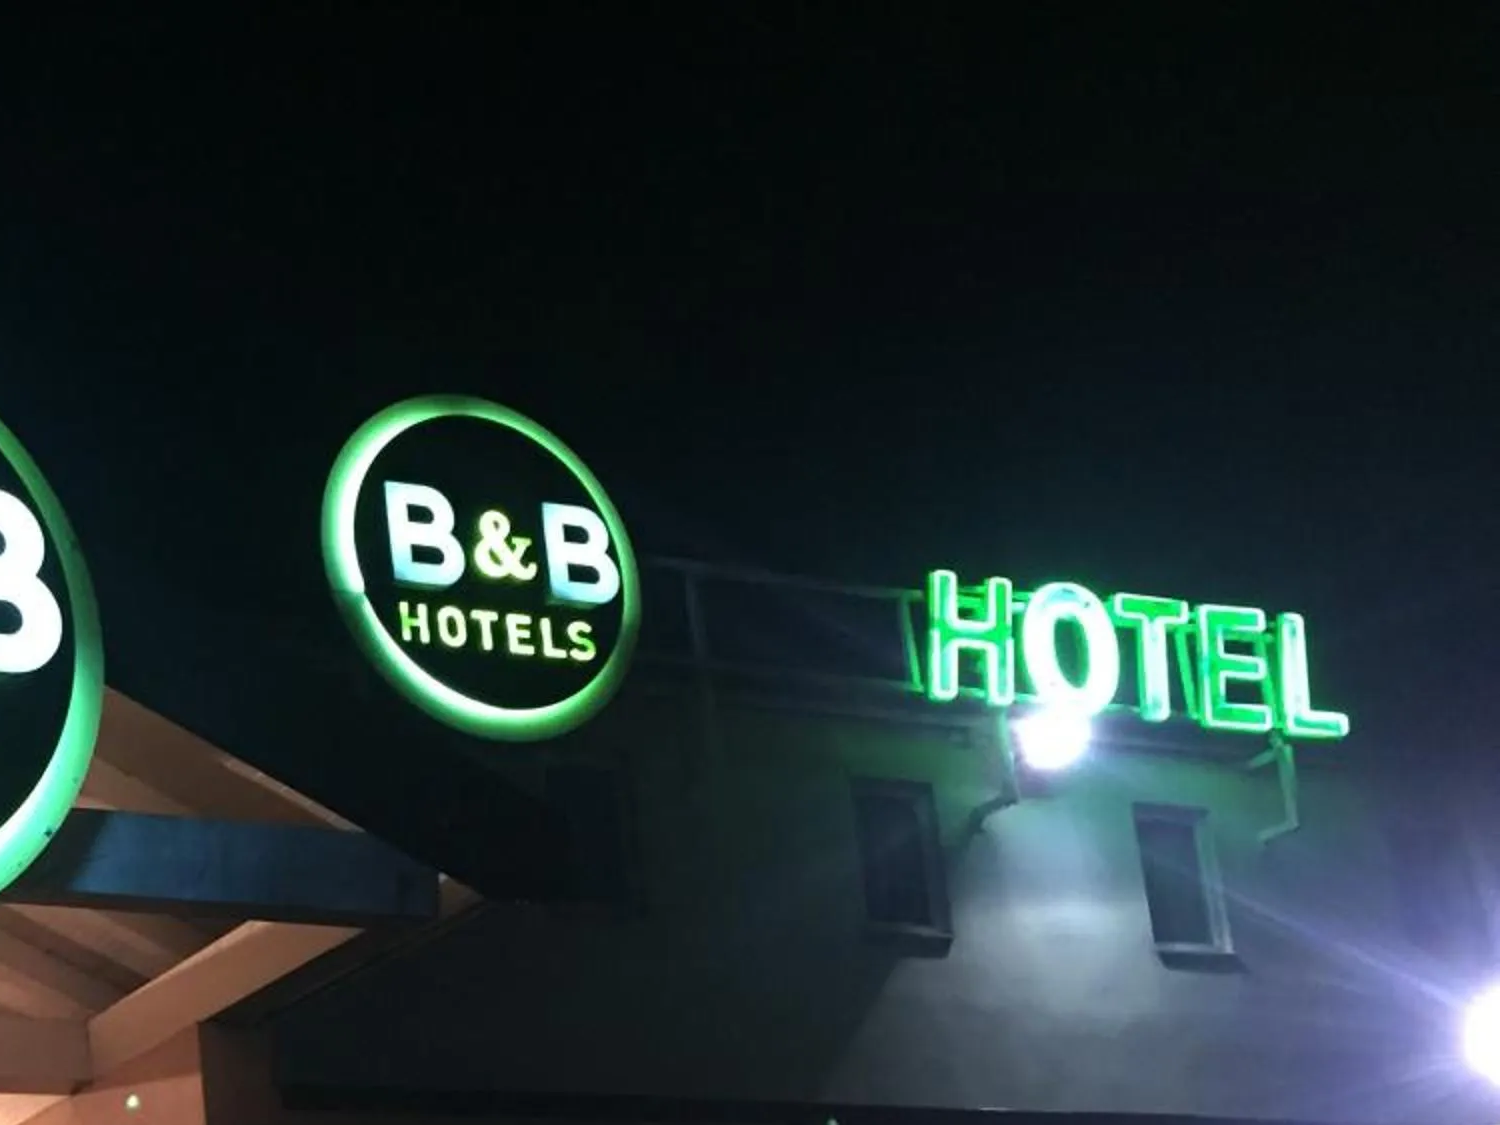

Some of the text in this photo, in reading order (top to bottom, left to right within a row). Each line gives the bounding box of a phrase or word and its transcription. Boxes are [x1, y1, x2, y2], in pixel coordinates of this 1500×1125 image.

[384, 480, 621, 605] B&B
[398, 601, 598, 662] HOTELS
[928, 568, 1350, 738] HOTEL
